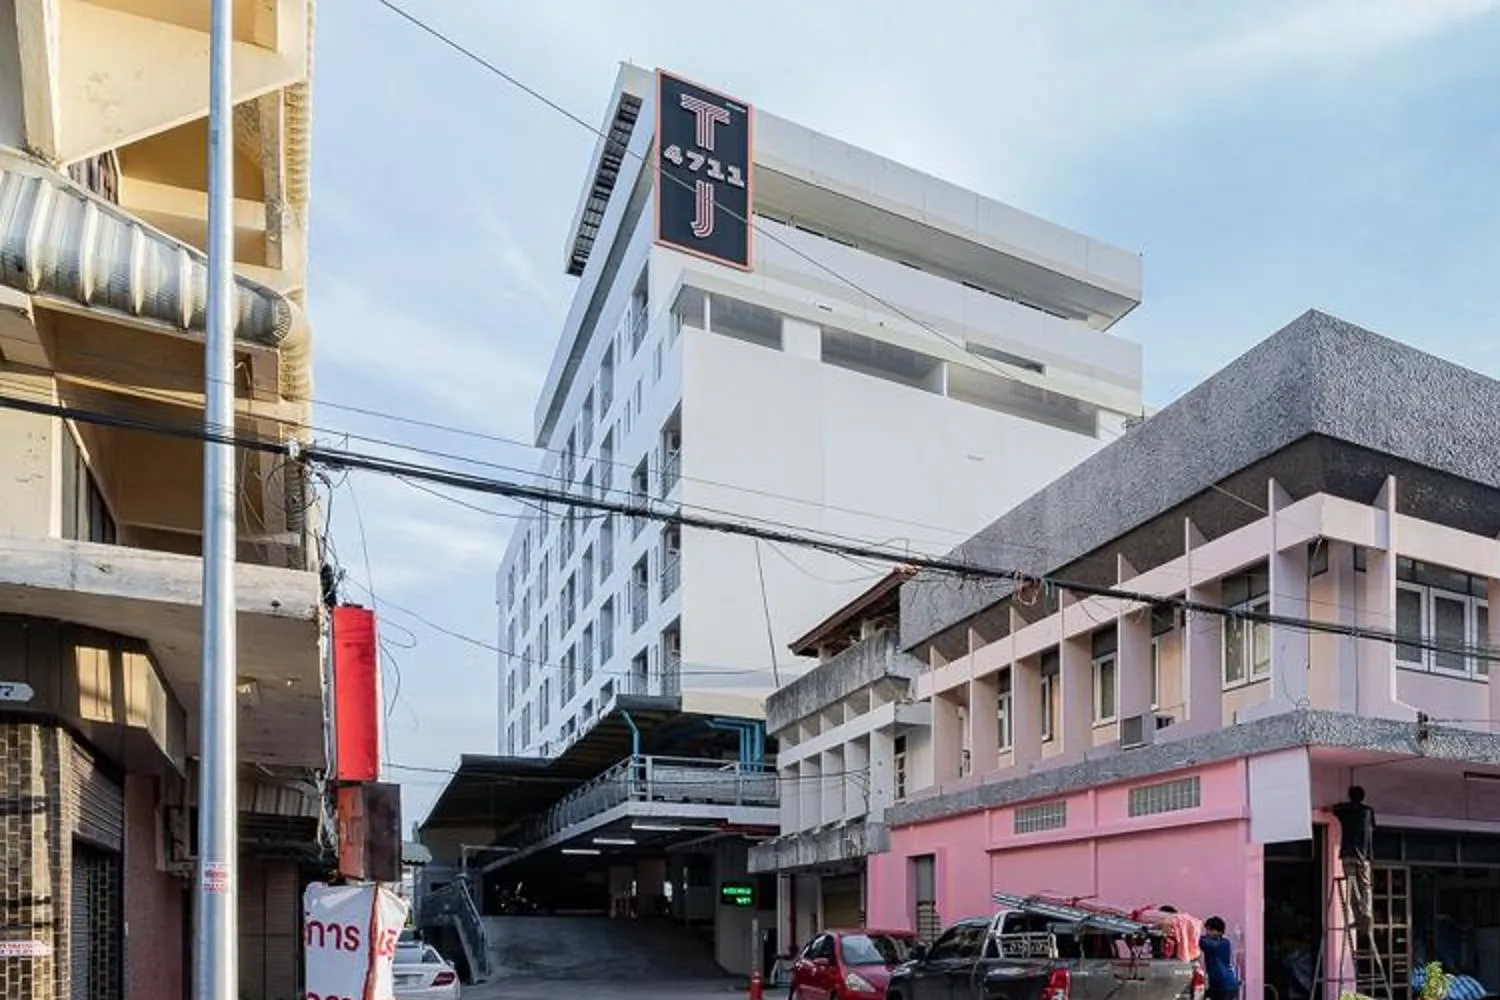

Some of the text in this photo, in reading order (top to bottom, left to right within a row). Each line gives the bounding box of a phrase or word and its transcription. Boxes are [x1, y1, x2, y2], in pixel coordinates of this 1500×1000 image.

[680, 93, 731, 151] T
[663, 143, 745, 188] 4711
[690, 180, 716, 238] J
